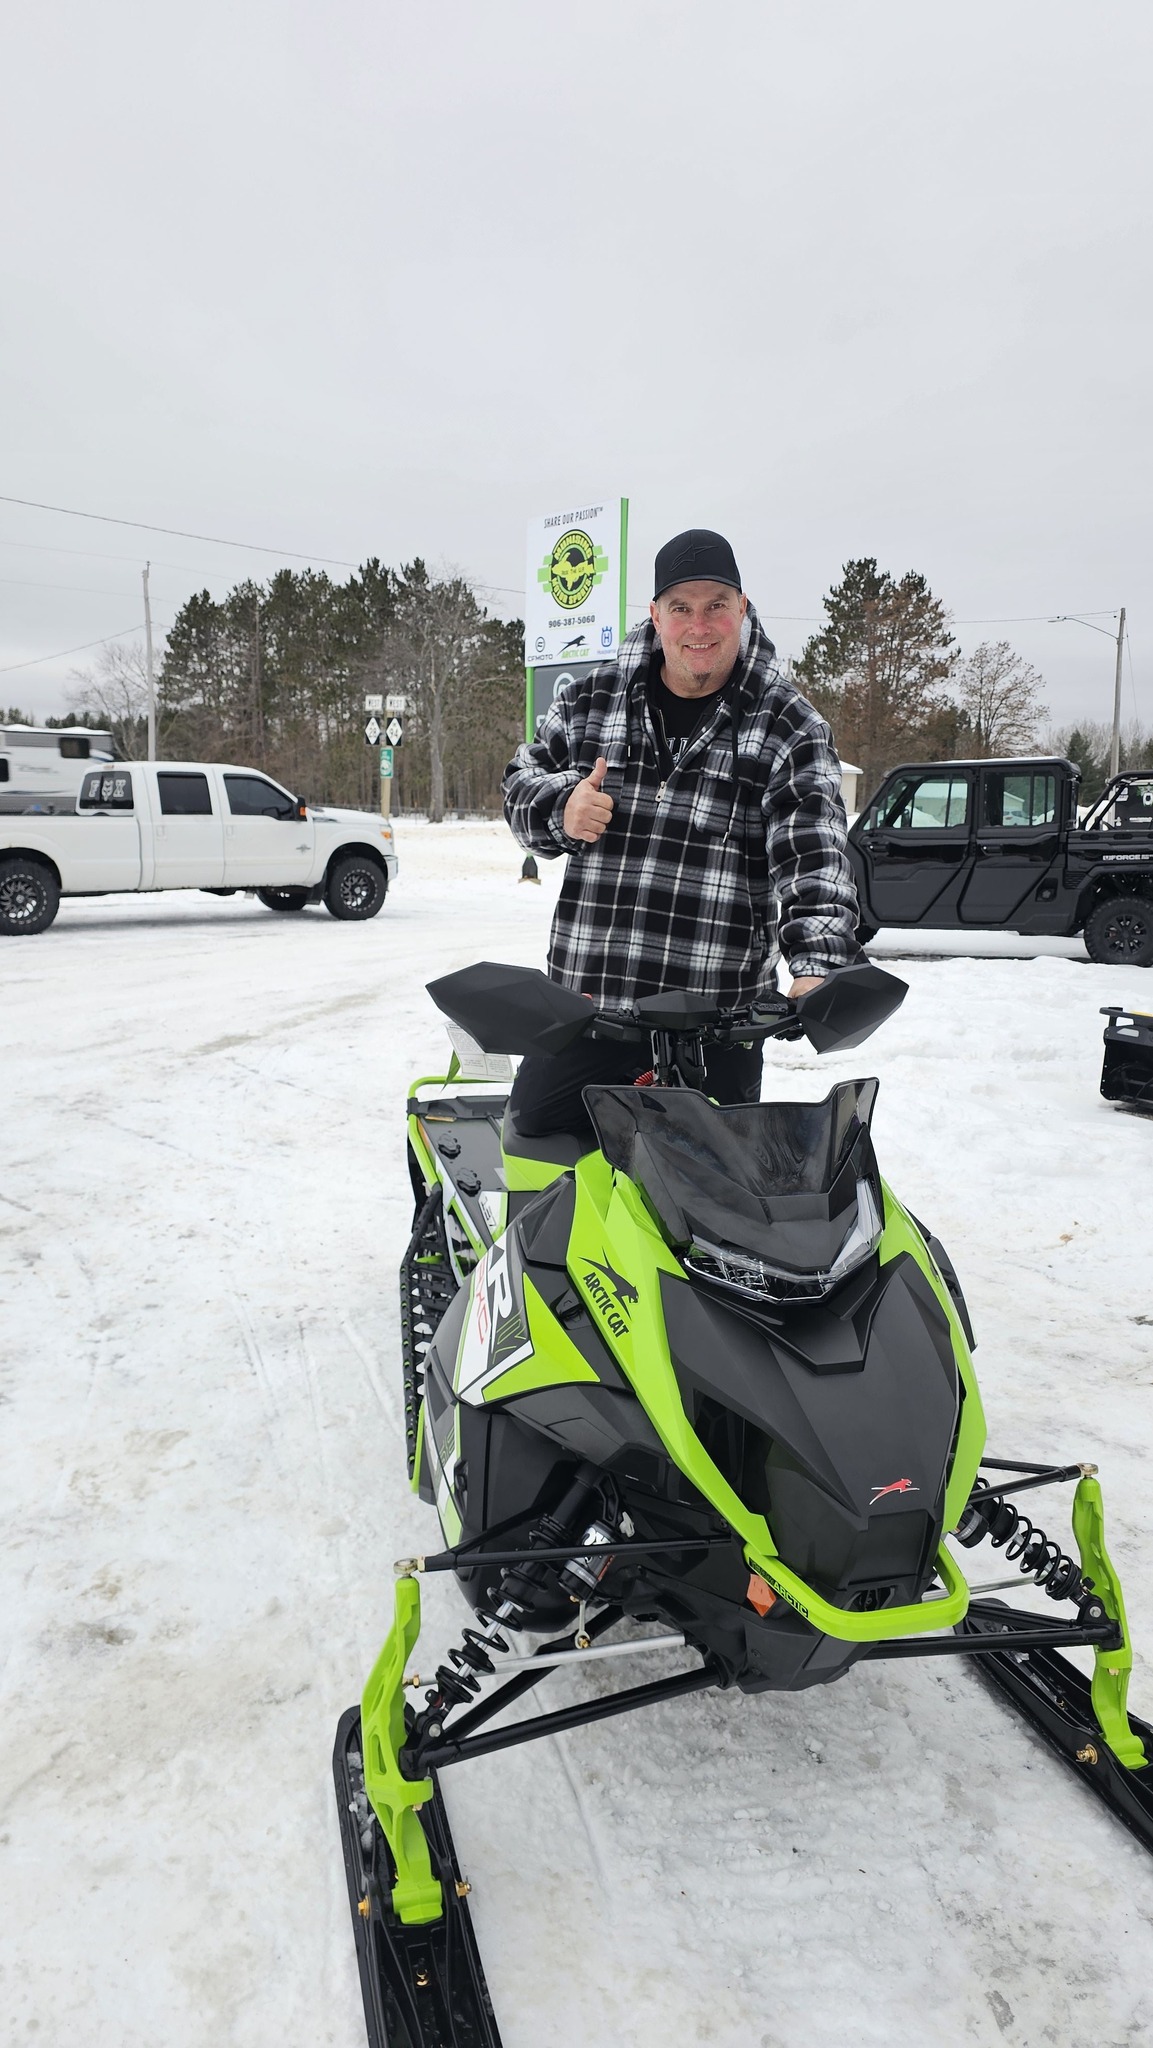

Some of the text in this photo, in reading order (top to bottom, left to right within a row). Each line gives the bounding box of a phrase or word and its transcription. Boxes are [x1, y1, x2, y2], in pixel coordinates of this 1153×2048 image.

[544, 515, 561, 529] SHARE
[562, 512, 574, 525] OUR
[548, 615, 596, 628] 906-387-5060
[527, 653, 553, 662] CFMOTO
[561, 648, 590, 659] ARCTIC CAT
[583, 1271, 630, 1338] ARCTIC CAT
[774, 1581, 808, 1618] ARCTIC
